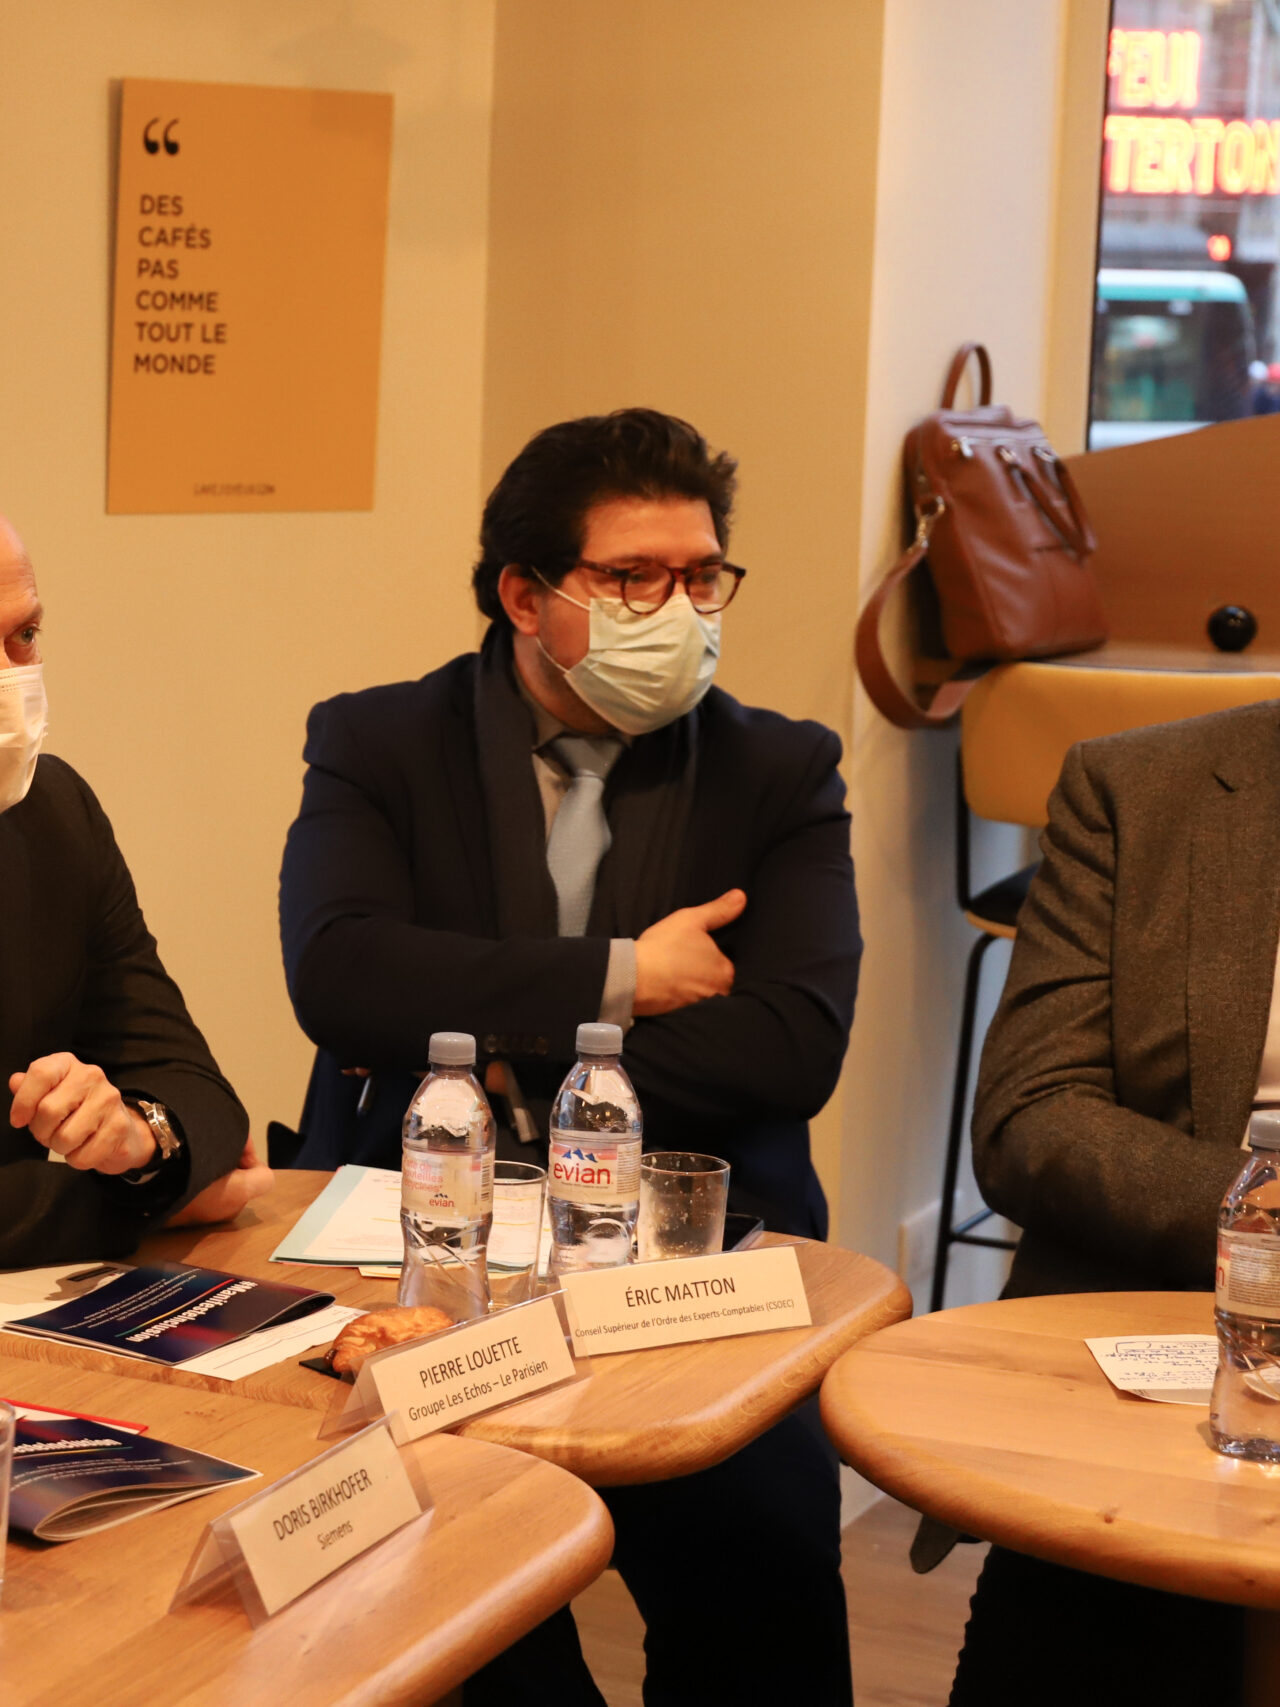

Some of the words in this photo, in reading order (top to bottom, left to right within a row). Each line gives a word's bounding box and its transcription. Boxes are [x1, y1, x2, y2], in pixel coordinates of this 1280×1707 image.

[139, 194, 184, 217] DES
[137, 223, 212, 250] CAFÉS
[137, 258, 180, 280] PAS
[135, 290, 220, 313] COMME
[135, 321, 195, 344] TOUT
[200, 323, 228, 345] LE
[133, 353, 216, 376] MONDE
[553, 1162, 612, 1185] evian
[428, 1198, 456, 1208] evian
[625, 1286, 663, 1308] ÉRIC
[664, 1277, 736, 1304] MATTON
[125, 1280, 259, 1343] #ManifesteInclusion
[575, 1325, 602, 1338] Conseil
[603, 1320, 639, 1336] Supérieur
[641, 1318, 651, 1329] de
[679, 1313, 693, 1324] des
[693, 1303, 765, 1322] Experts-Comptables
[766, 1298, 795, 1312] (CSOEC)
[419, 1357, 466, 1388] PIERRE
[465, 1336, 522, 1371] LOUETTE
[408, 1399, 446, 1422] Groupe
[445, 1391, 464, 1408] Les
[463, 1380, 493, 1400] Echos
[499, 1373, 512, 1388] Le
[512, 1359, 549, 1383] Parisien
[272, 1503, 312, 1541] DORIS
[308, 1468, 373, 1520] BIRKHOFER
[316, 1520, 354, 1551] Siemens
